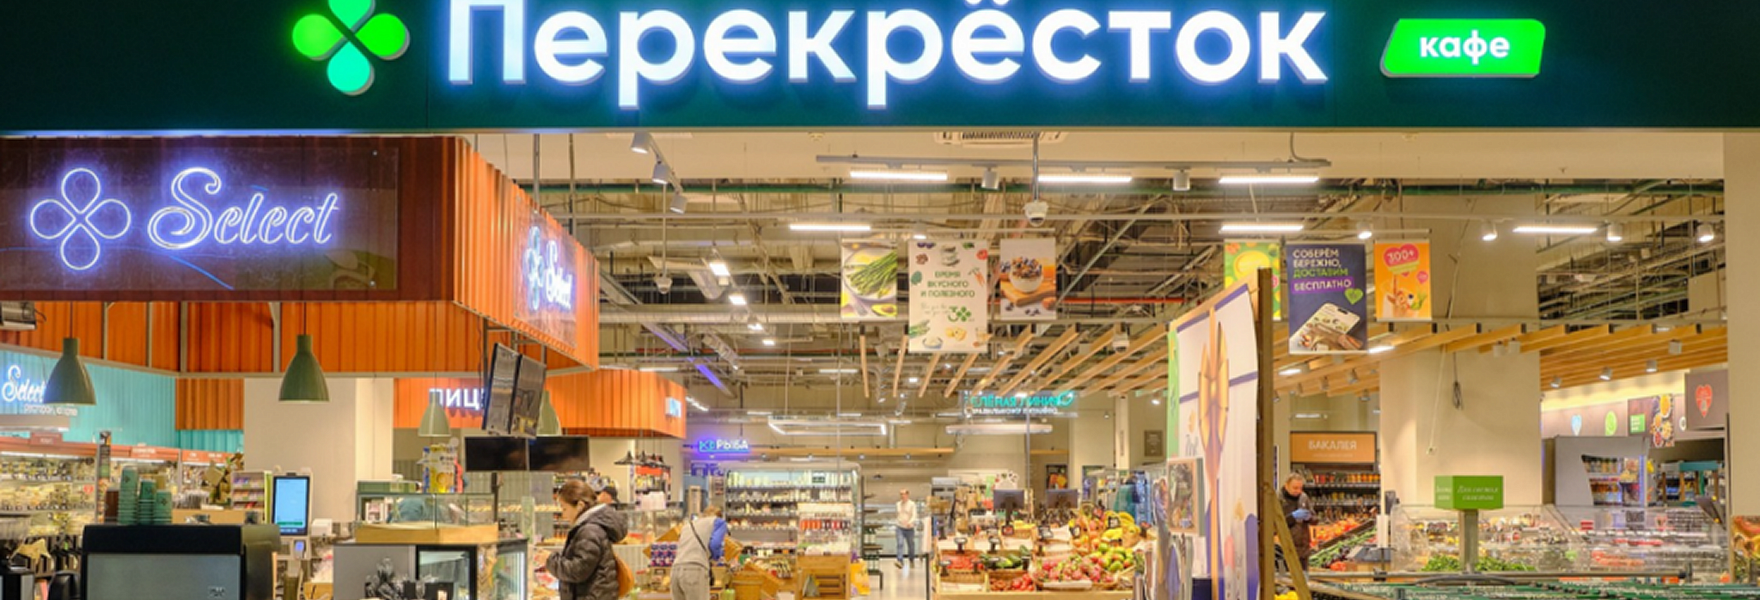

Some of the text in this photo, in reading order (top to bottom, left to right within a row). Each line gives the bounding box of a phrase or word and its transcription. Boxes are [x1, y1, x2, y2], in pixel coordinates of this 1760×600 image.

[1420, 30, 1510, 65] кафе
[449, 0, 1328, 109] Перекрёсток
[147, 167, 340, 249] Select
[1292, 247, 1339, 259] СОБЕРЁМ
[1293, 258, 1342, 268] БЕРЕЖНО,
[1293, 268, 1349, 278] ДОСТАВИМ
[1294, 279, 1352, 291] БЕСПЛАТНО
[928, 290, 976, 298] ПОЛЕЗНОГО
[429, 388, 485, 411] ПИЦ
[1308, 440, 1357, 450] БАКАЛЕЯ
